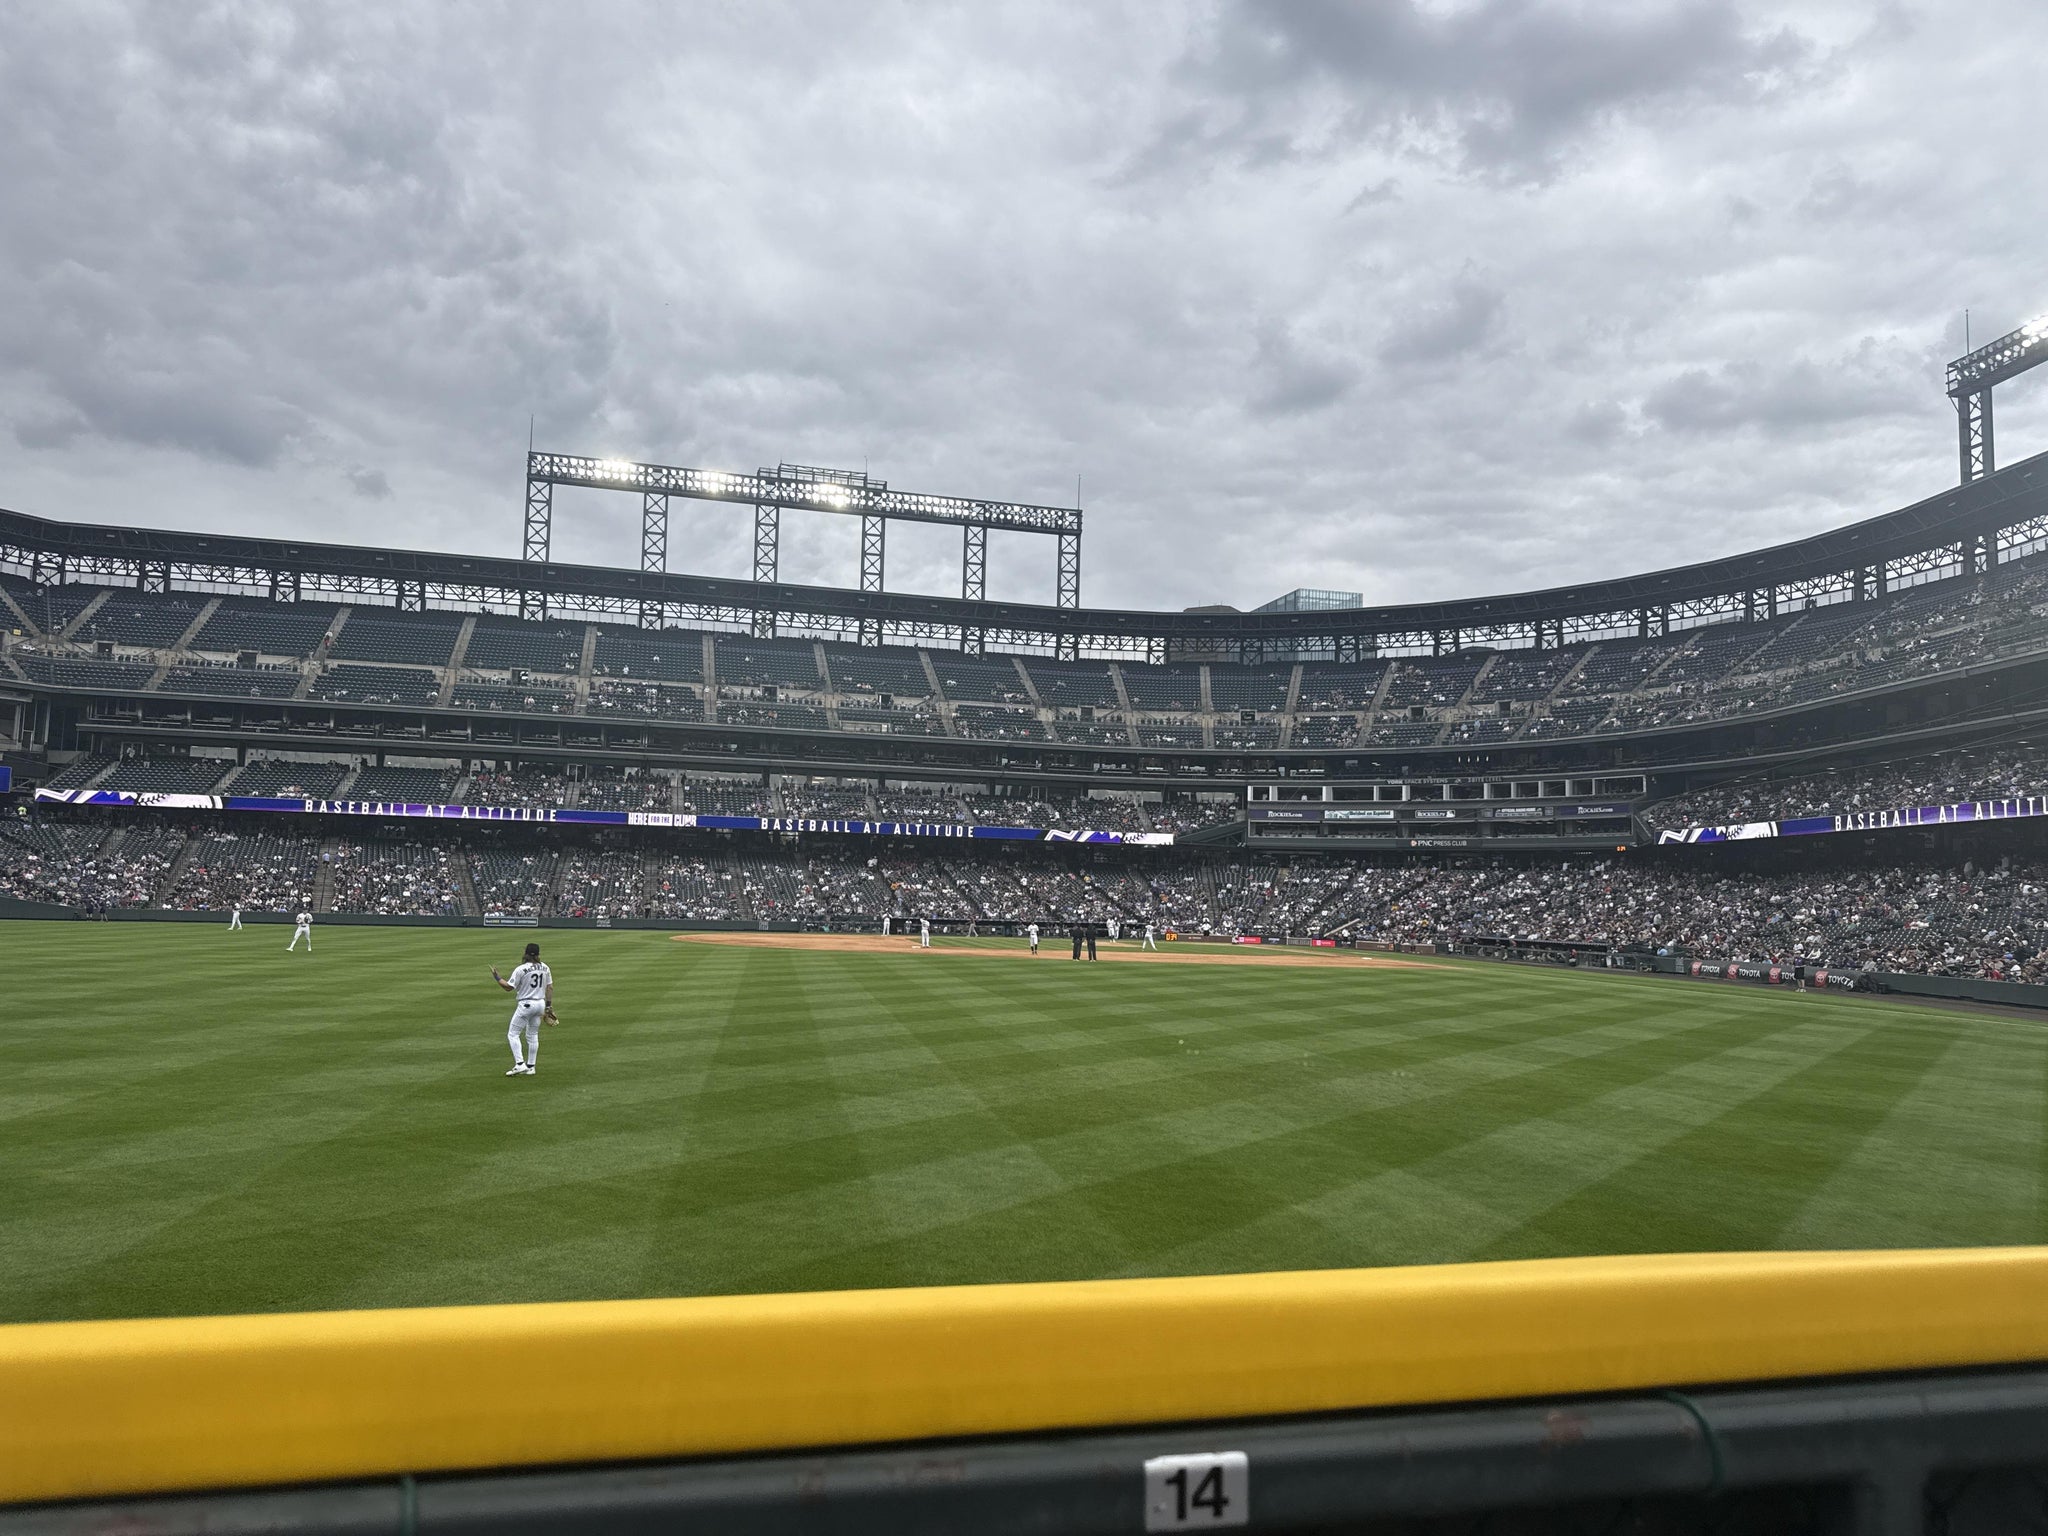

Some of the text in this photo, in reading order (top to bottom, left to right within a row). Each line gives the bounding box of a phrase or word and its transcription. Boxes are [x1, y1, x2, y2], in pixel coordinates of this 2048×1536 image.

[305, 799, 557, 822] BASEBALL AT ALTITUDE
[628, 812, 648, 826] HERE
[650, 815, 660, 824] FOR
[661, 815, 670, 824] THE
[1835, 807, 1924, 832] BASEBALL
[1939, 804, 1959, 823] AT
[761, 817, 974, 838] BASEBALL AT ALTITUDE
[1701, 965, 1720, 974] TOYOTA
[1739, 968, 1761, 978] TOYOTA
[530, 973, 543, 988] 31
[1165, 1466, 1229, 1520] 14
